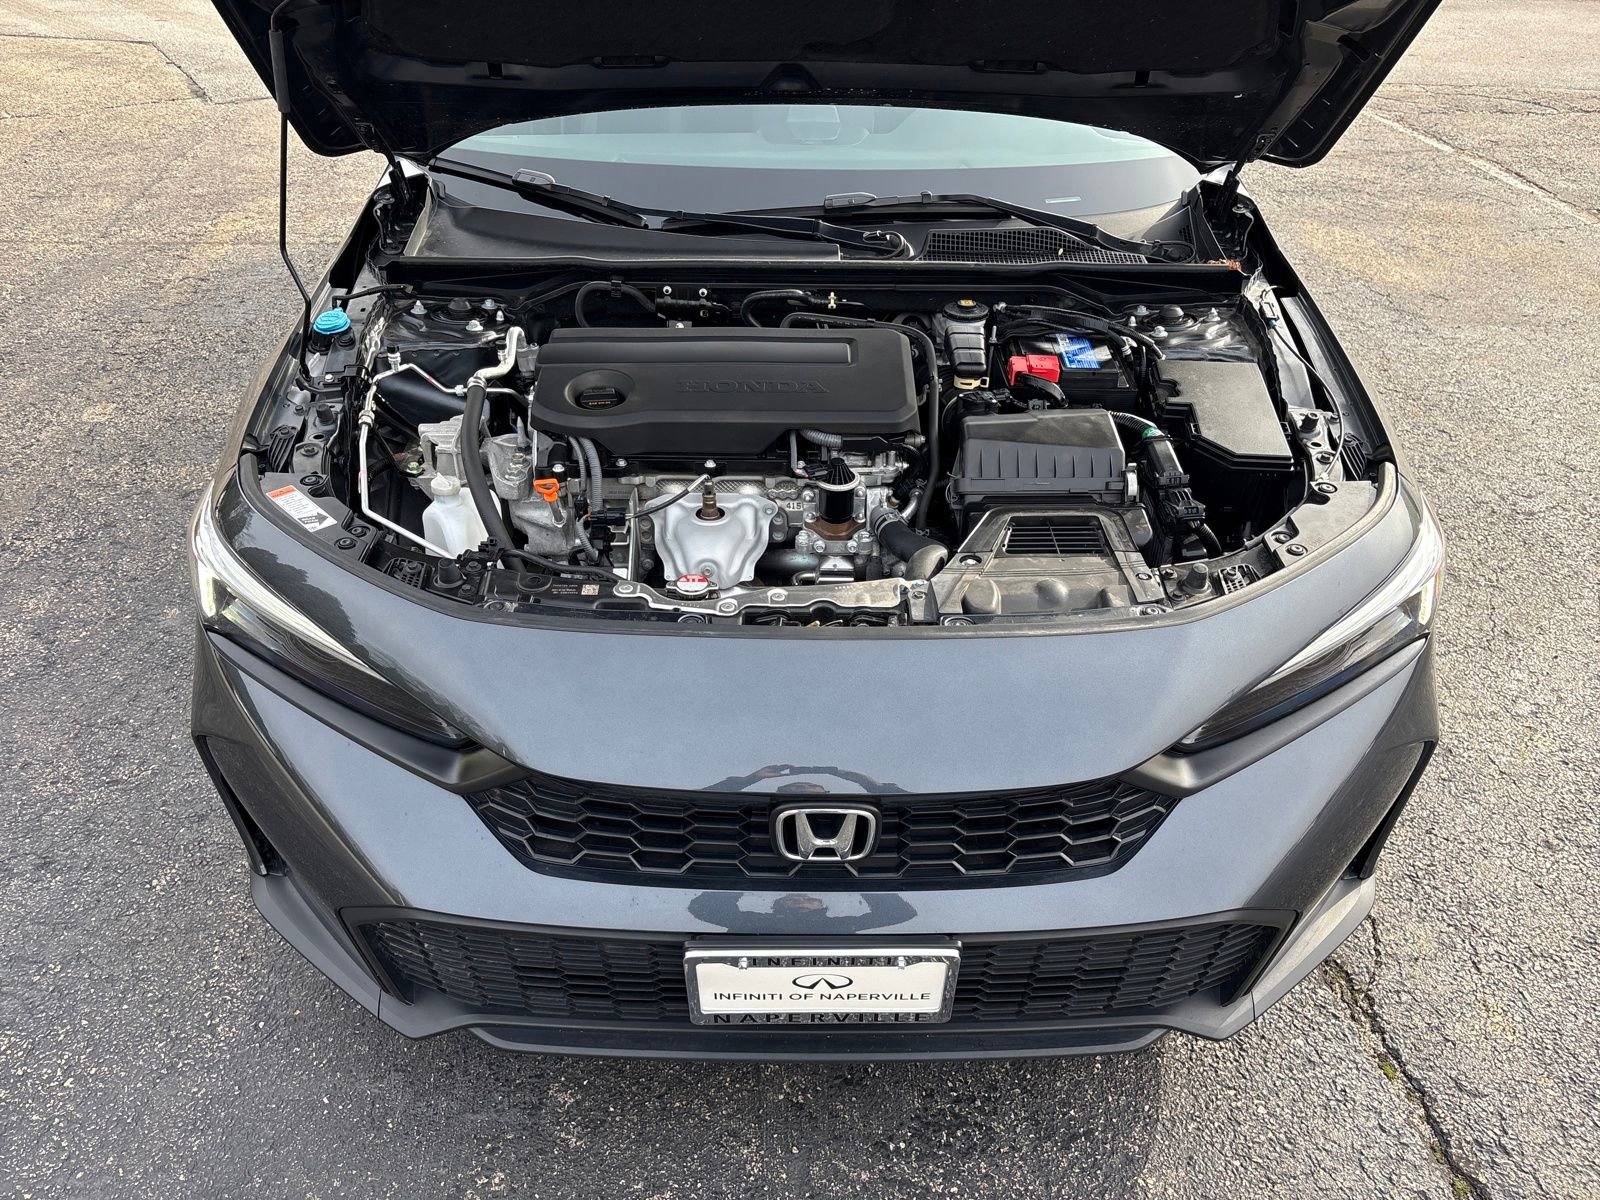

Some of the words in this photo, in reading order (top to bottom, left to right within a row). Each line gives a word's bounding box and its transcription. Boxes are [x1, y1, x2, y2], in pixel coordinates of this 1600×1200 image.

[675, 379, 830, 393] HONDA
[785, 502, 802, 510] 415
[752, 957, 892, 967] INFINITI
[713, 992, 783, 1001] INFINITI
[789, 993, 814, 1001] OF
[819, 992, 931, 1001] NAPERVILLE
[713, 1012, 929, 1024] NAPERVILLE
